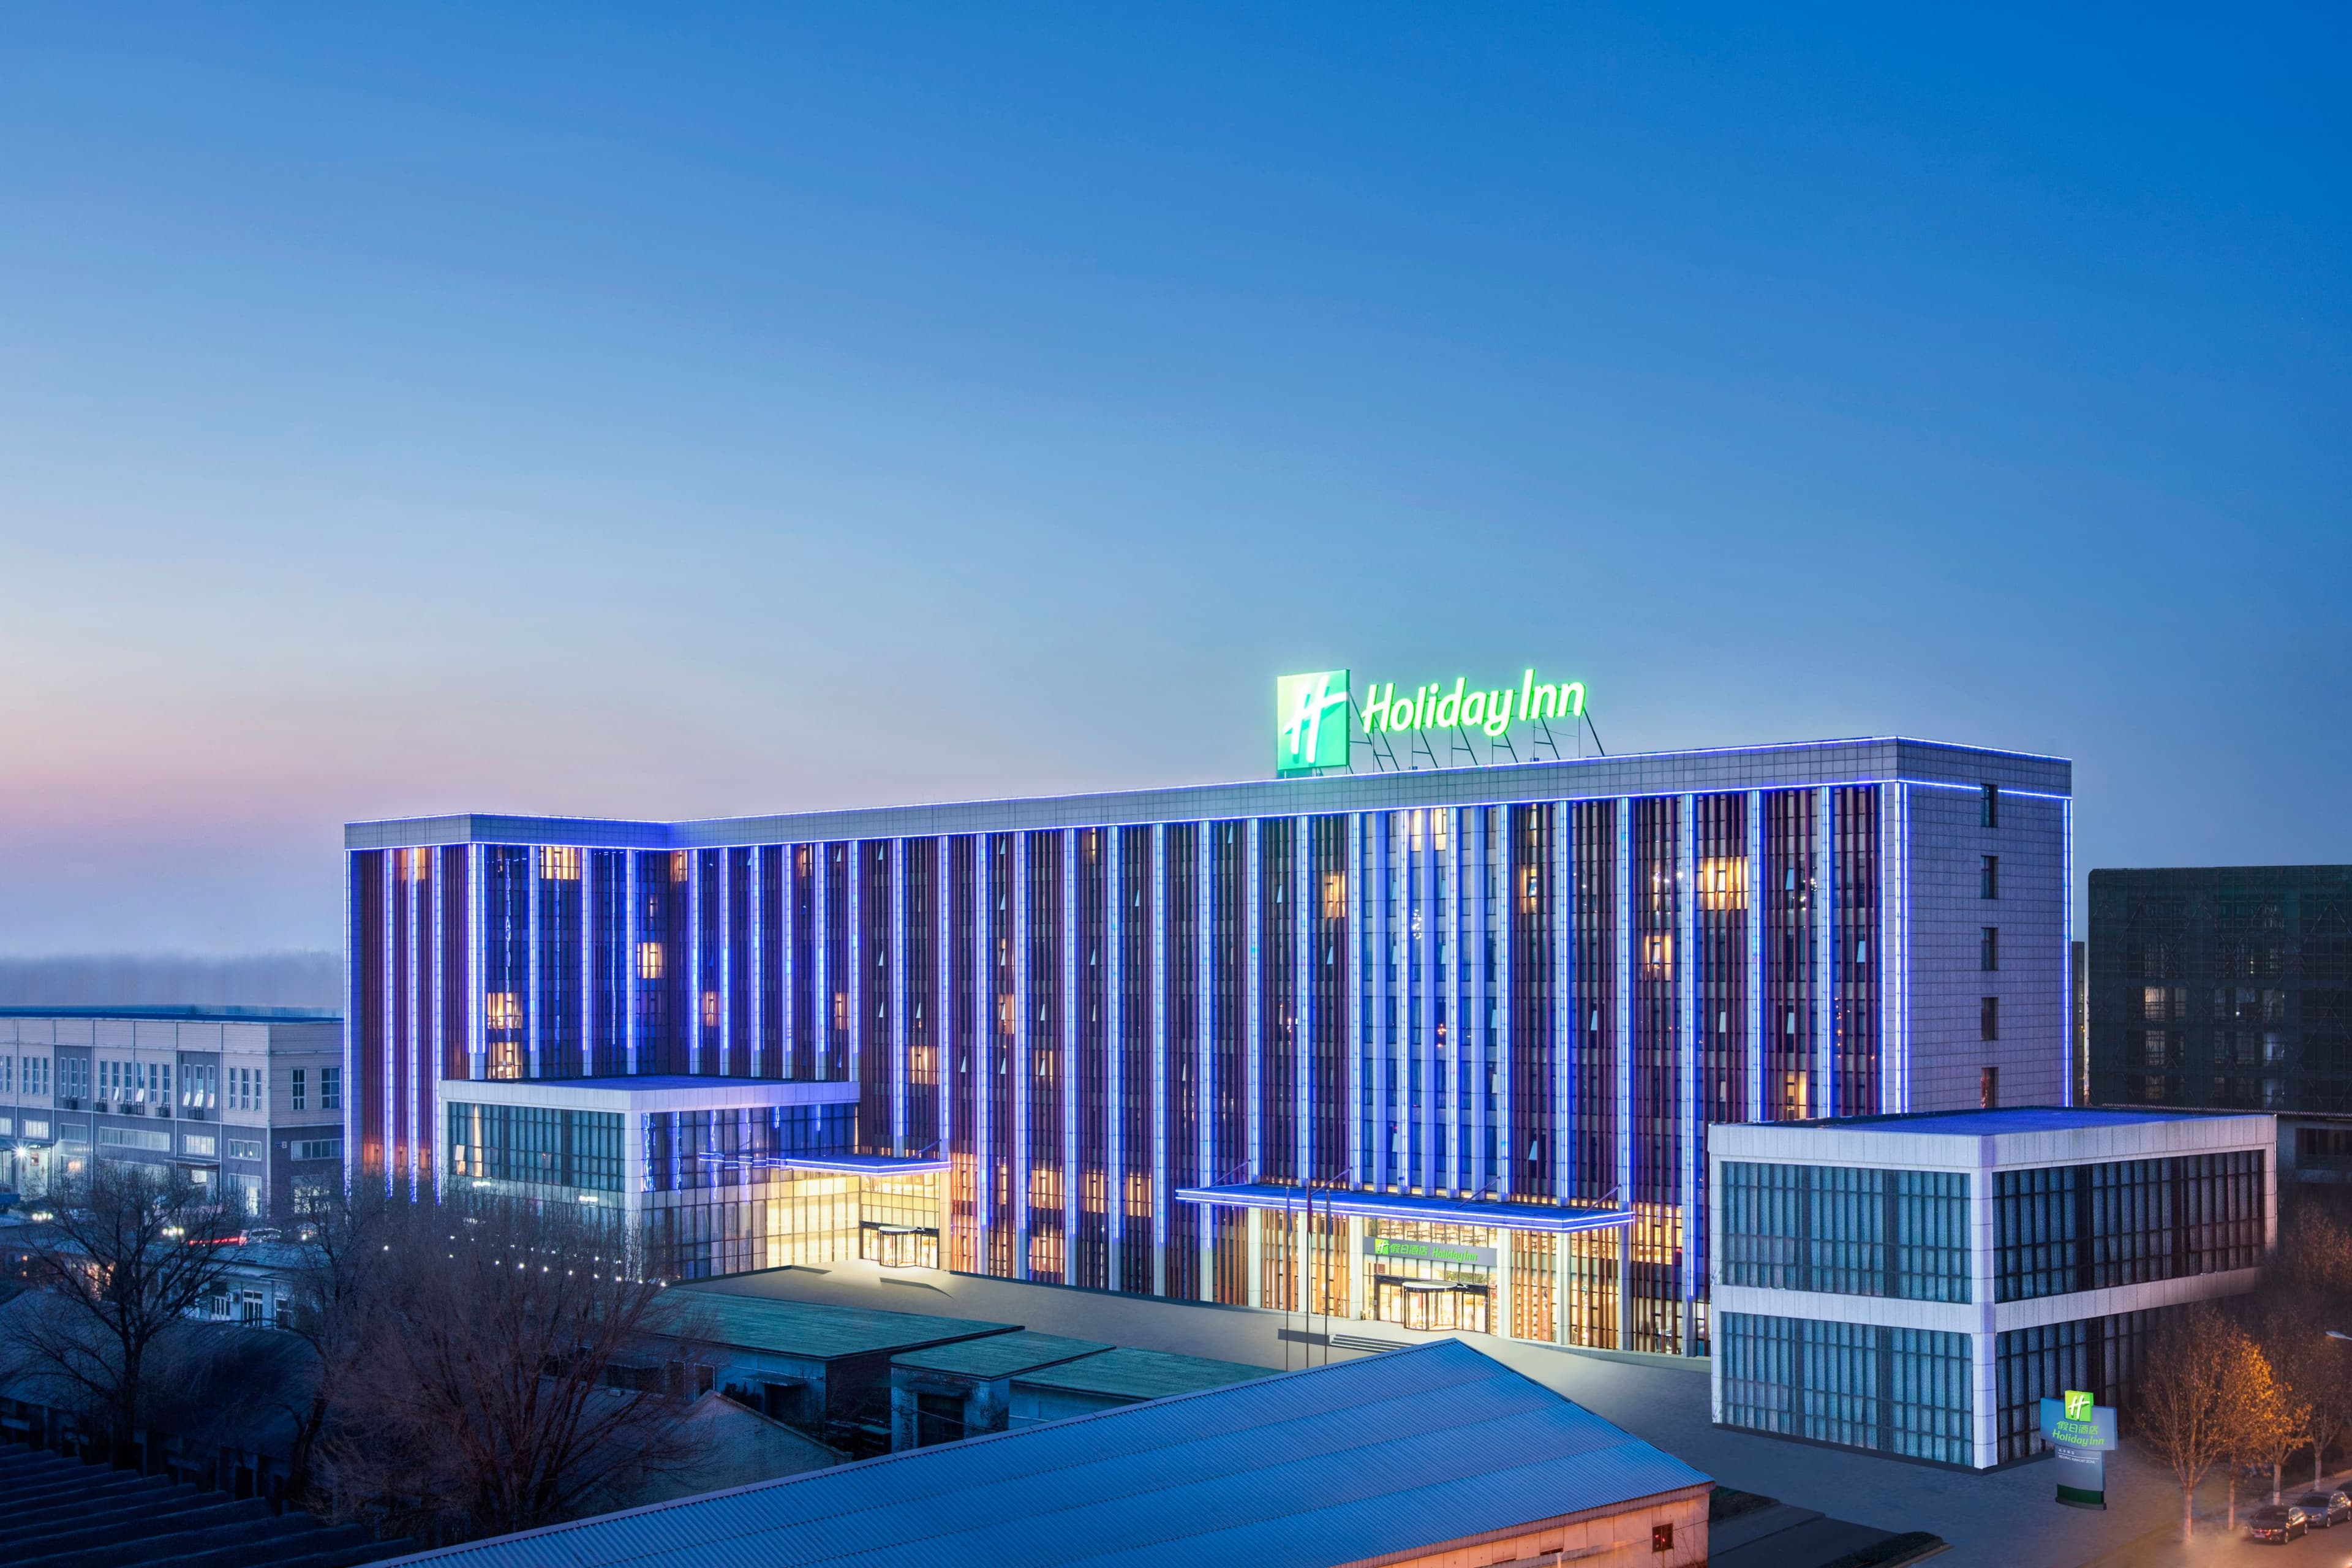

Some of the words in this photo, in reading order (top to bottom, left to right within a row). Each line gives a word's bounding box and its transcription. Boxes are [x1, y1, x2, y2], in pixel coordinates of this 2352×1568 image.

[1361, 677, 1515, 737] Holiday
[1518, 668, 1586, 722] Inn
[1389, 1243, 1428, 1256] 假日酒店
[1432, 1246, 1464, 1262] Holiday
[1464, 1248, 1477, 1261] Inn
[2056, 1420, 2098, 1435] 假日酒店
[2052, 1428, 2088, 1447] Holiday
[2089, 1435, 2105, 1446] Inn
